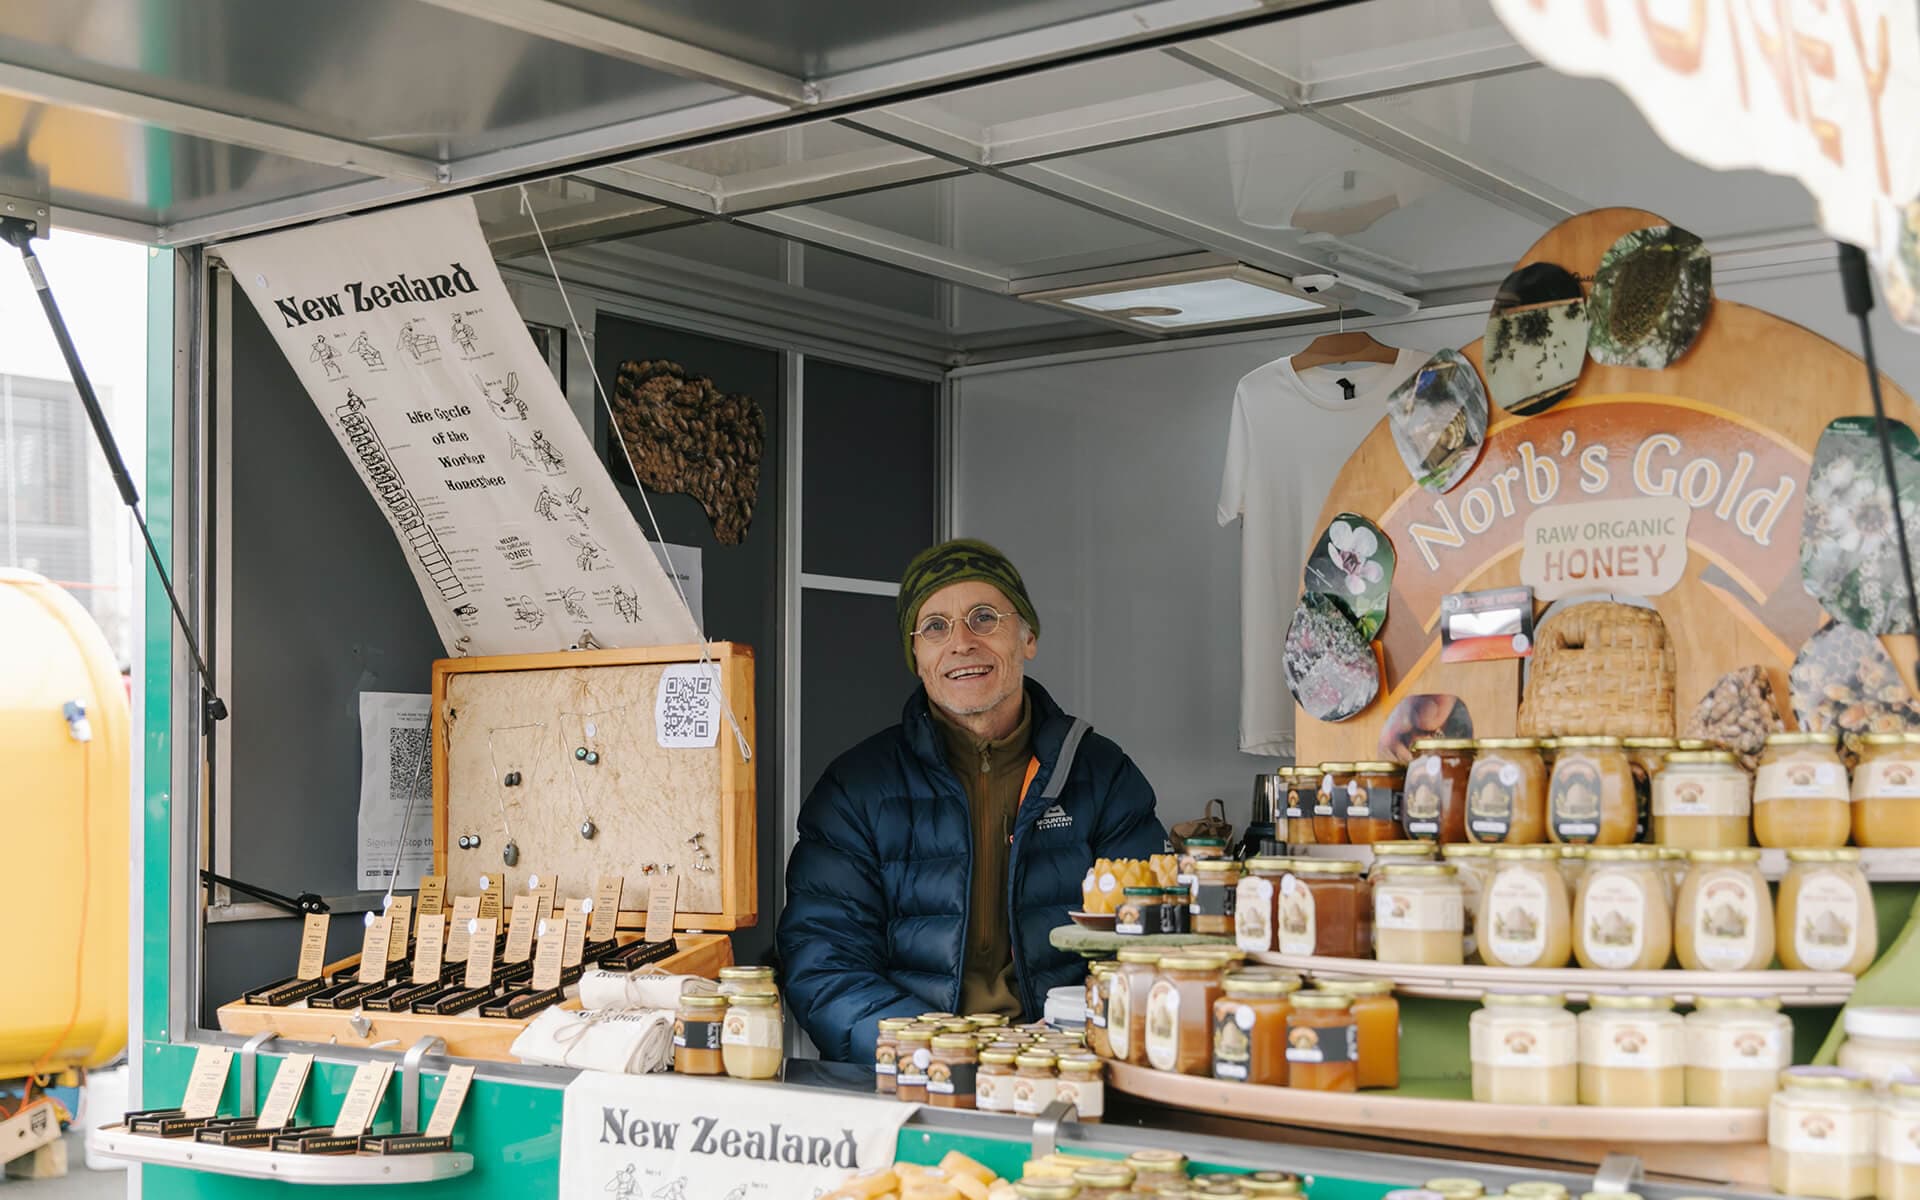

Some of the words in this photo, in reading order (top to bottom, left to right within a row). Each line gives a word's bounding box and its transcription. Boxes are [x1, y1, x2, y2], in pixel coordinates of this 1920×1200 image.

[1520, 0, 1893, 197] ONEY
[274, 293, 345, 329] New
[344, 262, 480, 313] Zealand
[406, 411, 433, 424] Life
[433, 405, 471, 422] Cycle
[432, 432, 446, 445] of
[446, 431, 469, 442] the
[438, 452, 486, 468] Worker
[445, 475, 506, 491] Honeybee
[1633, 434, 1796, 546] Gold
[1535, 522, 1580, 545] RAW
[1583, 518, 1676, 541] ORGANIC
[502, 549, 533, 560] HONEY
[1543, 544, 1667, 582] HONEY
[1036, 816, 1073, 826] MOUNTAIN
[275, 982, 319, 1001] CONTINUUM
[395, 986, 437, 1006] CONTINUUM
[444, 989, 489, 1010] CONTINUUM
[513, 993, 558, 1014] CONTINUUM
[309, 1138, 358, 1149] CONTINUUM
[392, 1140, 445, 1149] CONTINUUM
[599, 1106, 681, 1151] New
[689, 1115, 860, 1169] Zealand
